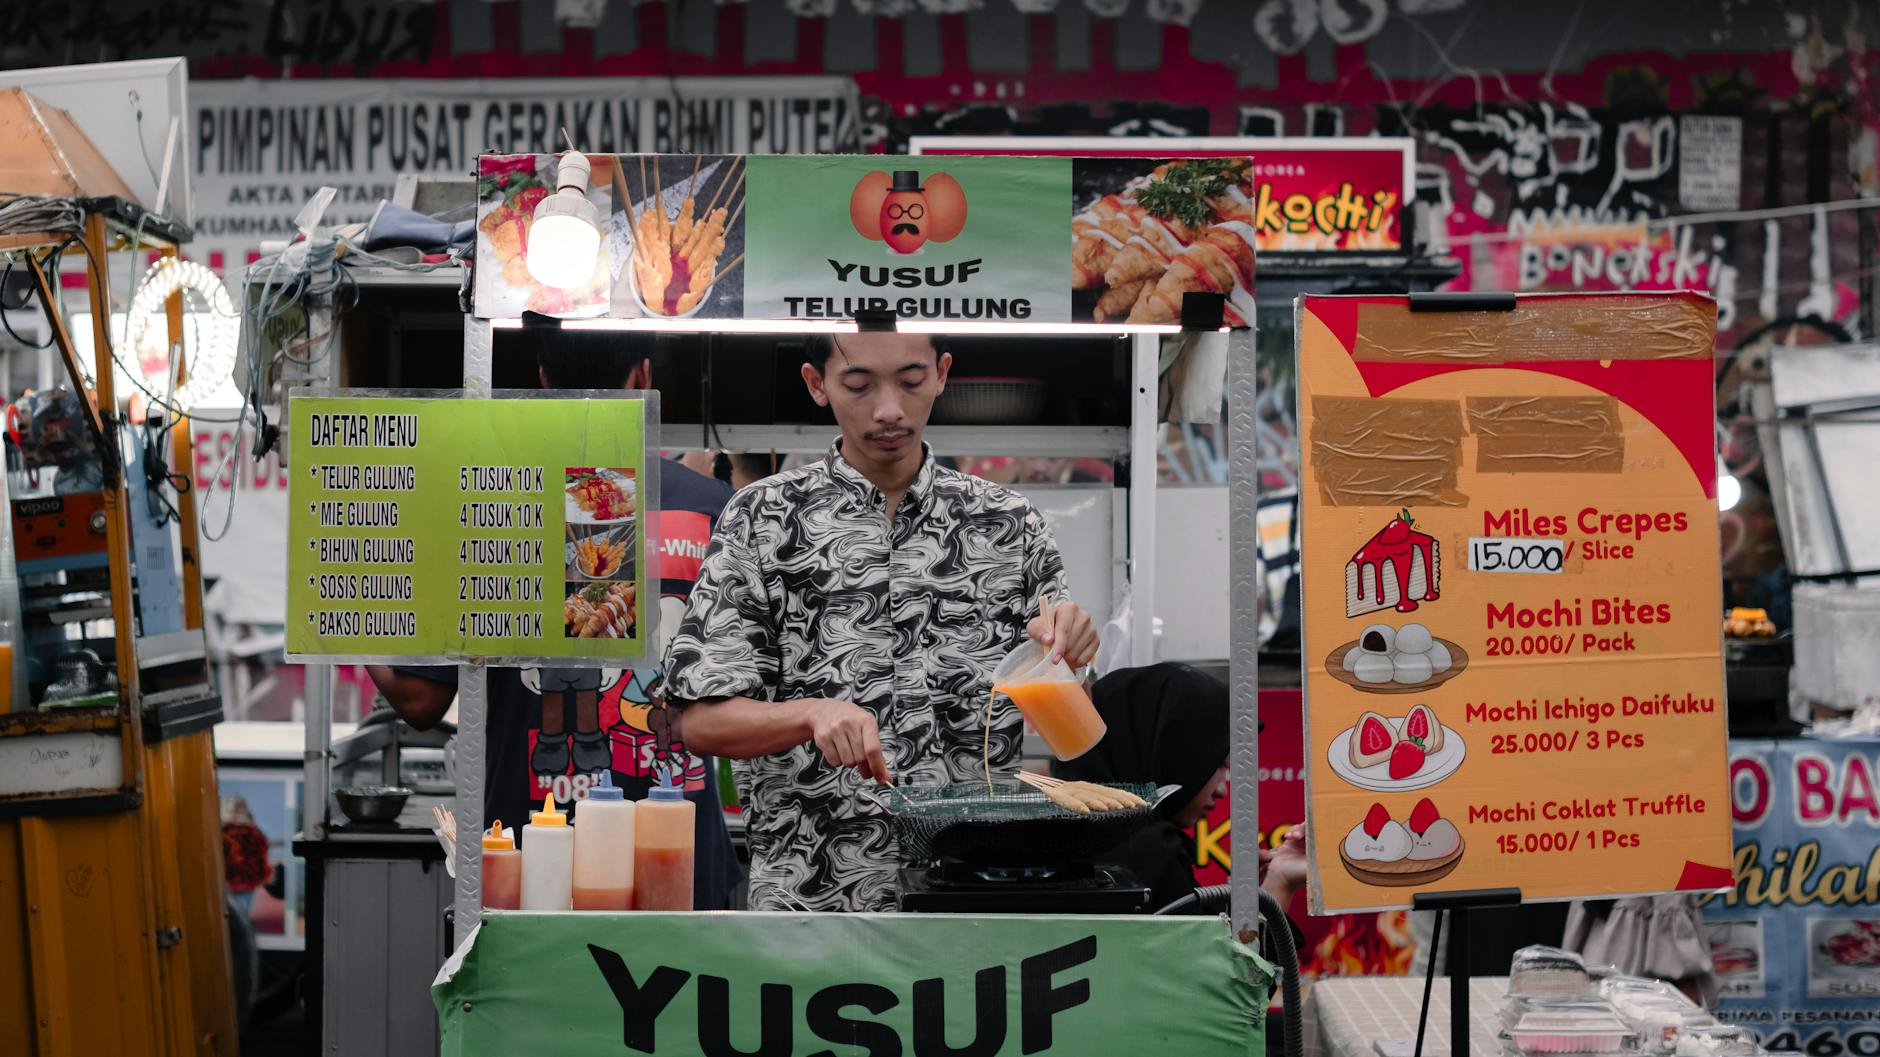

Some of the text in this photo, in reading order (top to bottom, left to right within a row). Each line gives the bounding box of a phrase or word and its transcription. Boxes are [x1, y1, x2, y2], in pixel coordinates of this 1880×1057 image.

[197, 104, 355, 174] PIMPINAN
[367, 103, 471, 172] PUSAT
[484, 99, 640, 153] GERAKAN
[228, 185, 394, 204] AKTA NTARI
[827, 257, 983, 289] YUSUF
[895, 296, 1032, 319] GULUNG
[311, 414, 418, 448] DAFTAR MENU
[321, 465, 543, 491] TELUR GULUNG 5 TUSUK 10 K
[321, 501, 543, 527] MIE GULUNG 4 TUSUK 10 K
[1483, 506, 1689, 540] Miles Crepes
[320, 538, 543, 564] BIHUN GULUNG 4 TUSUK 10 K
[1581, 540, 1635, 560] Slice
[320, 574, 542, 600] SOSIS GULUNG 2 TUSUK 10 K
[319, 611, 542, 637] BAKSO GULUNG 4 TUSUK 10 K
[1486, 596, 1671, 630] Mochi Bites
[1485, 631, 1636, 657] 20.000/ Pack
[1465, 692, 1715, 724] Mochi Ichigo Daifuku
[1490, 729, 1645, 755] 25.000/ 3 Pcs
[1468, 794, 1706, 824] Mochi Coklat Truffle
[1496, 829, 1641, 855] 15.000/ 1 Pcs
[586, 934, 1098, 1057] YUSUF
